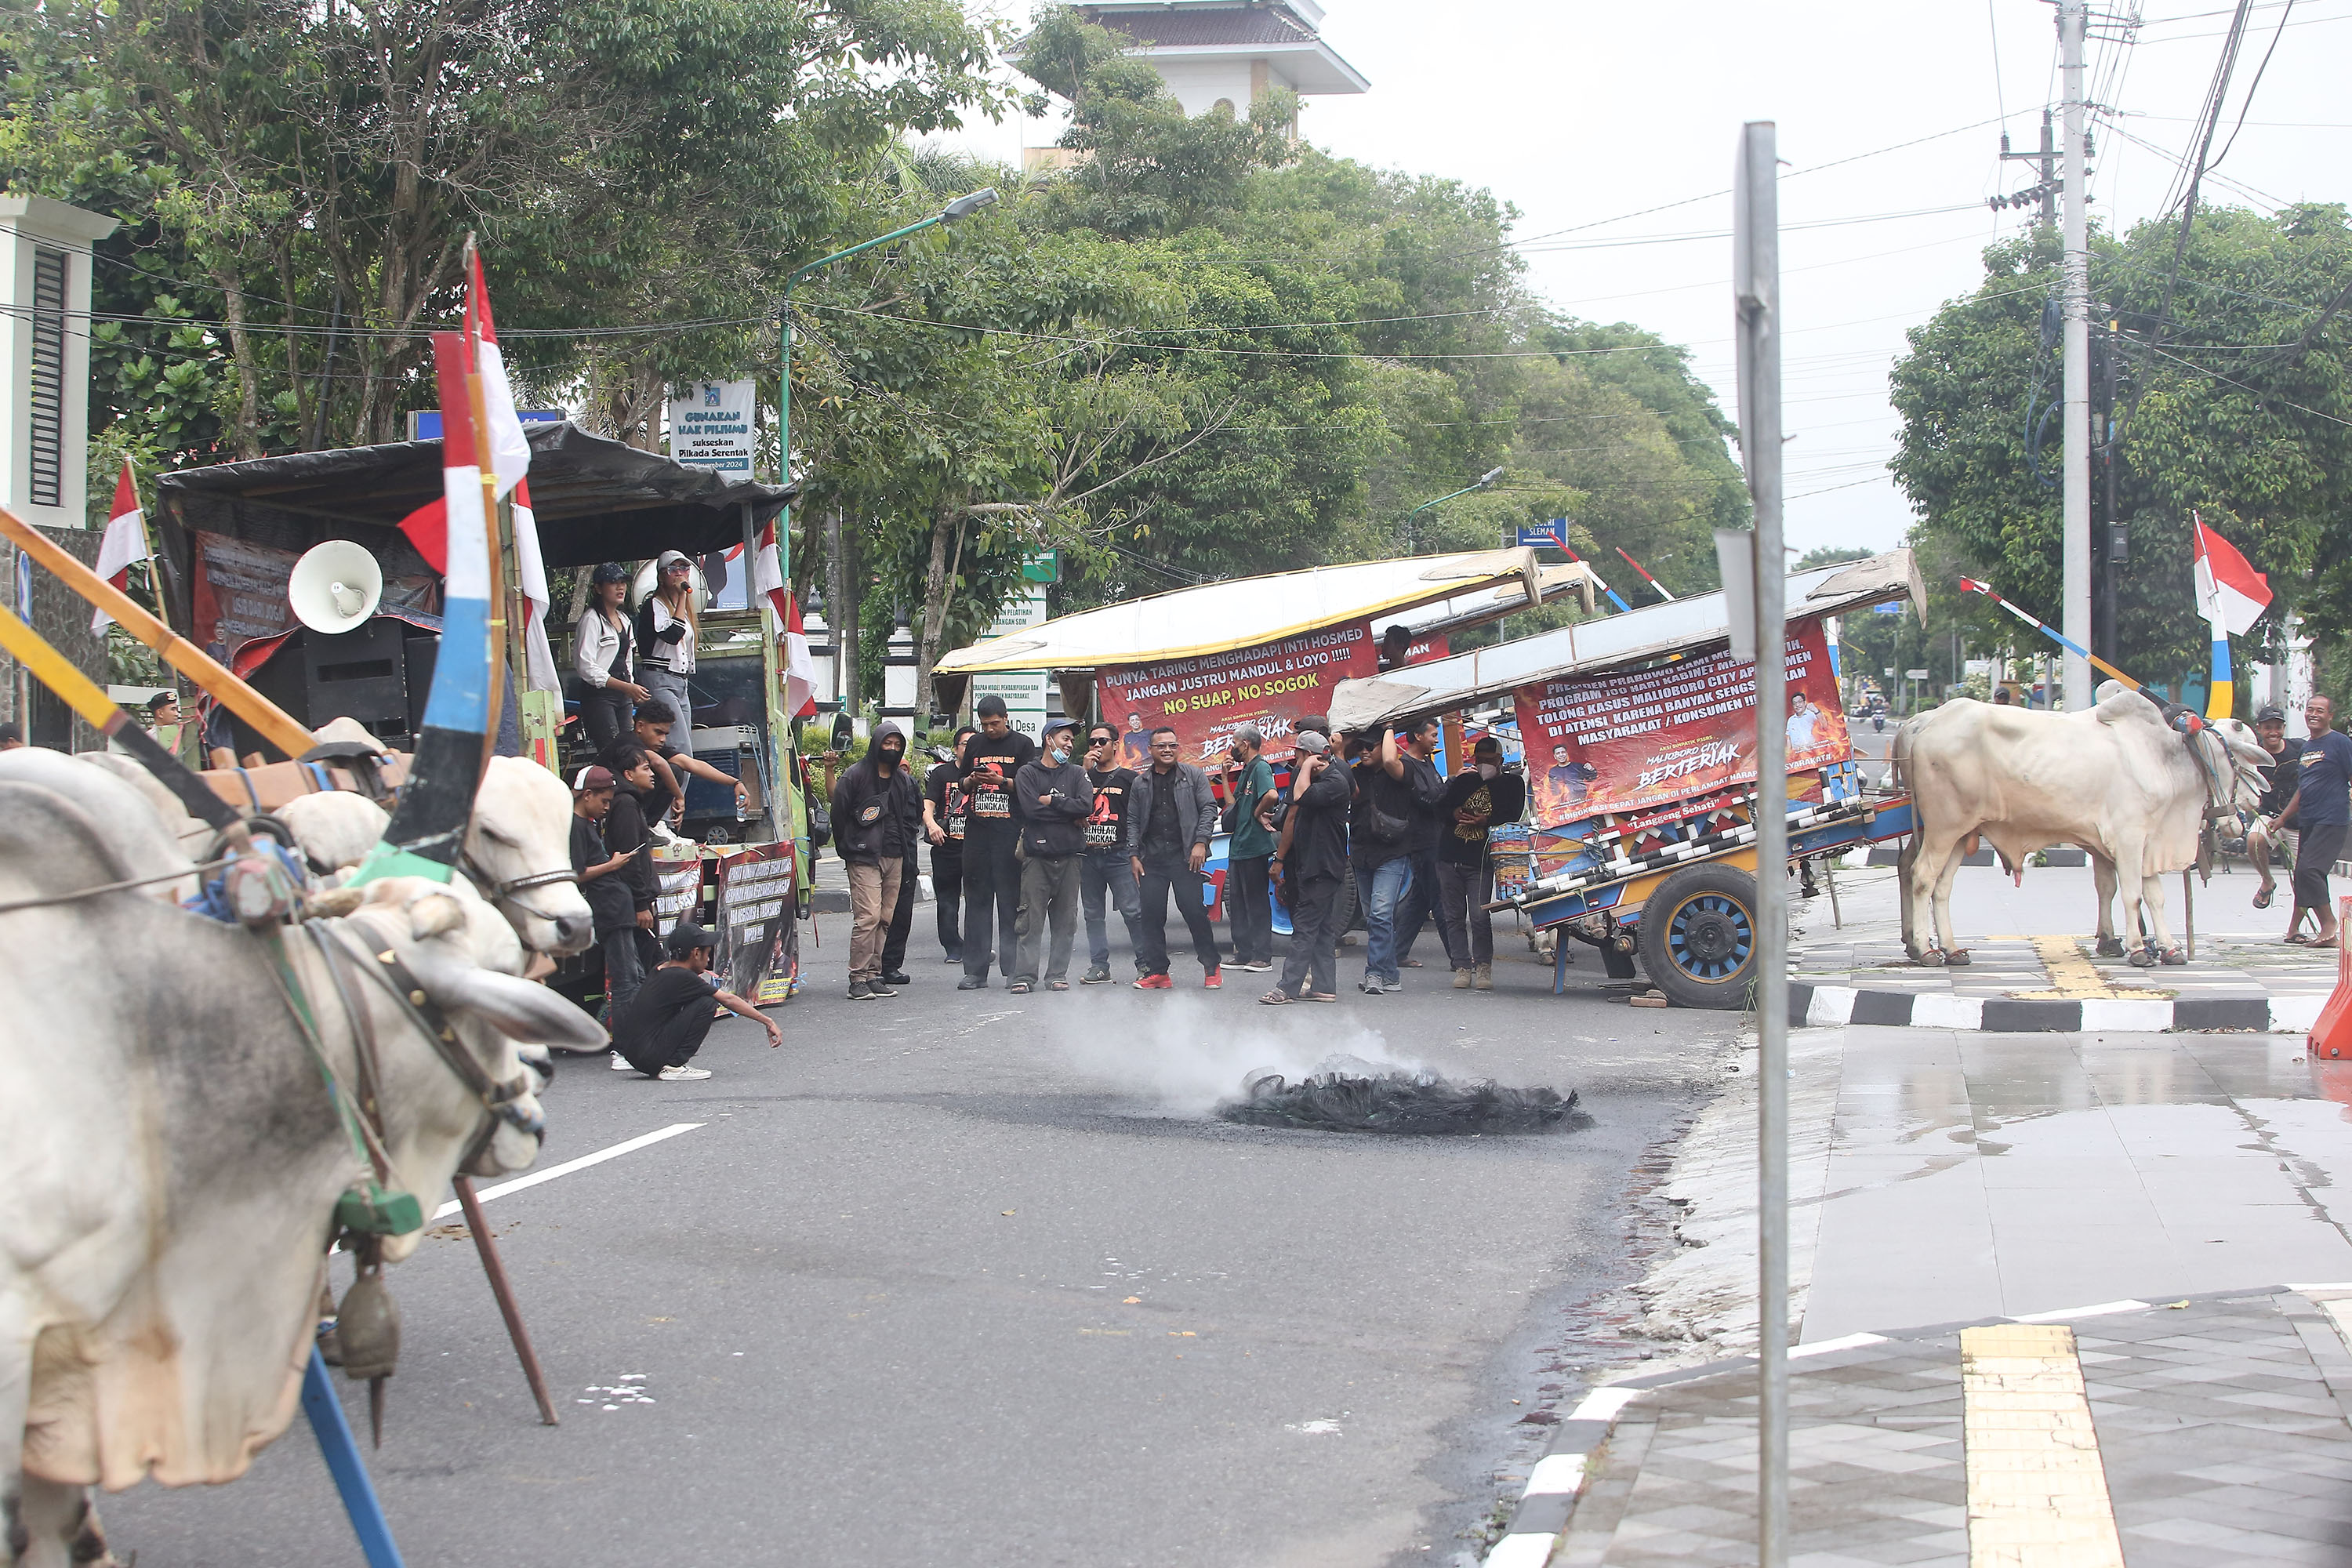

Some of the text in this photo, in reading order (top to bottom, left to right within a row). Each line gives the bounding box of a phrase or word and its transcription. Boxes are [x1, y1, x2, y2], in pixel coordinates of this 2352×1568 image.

[678, 424, 748, 435] HAK PILIHMU
[685, 411, 740, 422] GUNAKAN
[1105, 628, 1363, 688] PUNYA TARING MENGHADAPI INTI HOSMED
[1125, 681, 1178, 702] JANGAN
[1180, 671, 1227, 691] JUSTRU
[1229, 662, 1283, 682] MANDUL
[1285, 659, 1294, 671] &
[1296, 652, 1329, 669] LOYO
[1609, 666, 1674, 687] PRABOWO
[1675, 658, 1710, 672] KAMI
[1163, 672, 1320, 715] NO SUAP, NO SOGOK
[1536, 707, 1585, 725] TOLONG
[1587, 696, 1631, 715] KASUS
[1632, 680, 1706, 705] MALIOBORO
[1708, 670, 1737, 688] CITY
[1538, 690, 1602, 710] PROGRAM
[1603, 687, 1628, 697] 100
[1631, 680, 1661, 693] HARI
[1664, 664, 1715, 685] KABINET
[1016, 720, 1036, 732] Desa
[1232, 712, 1253, 720] SIMPATIK
[1258, 713, 1277, 725] CITY
[1548, 724, 1563, 738] DI
[1565, 715, 1607, 735] ATENSI
[1613, 705, 1664, 724] KARENA
[1665, 692, 1715, 712] BANYAK
[1577, 718, 1662, 746] MASYARAKAT
[1665, 716, 1671, 728] /
[1673, 698, 1743, 725] KONSUMEN
[1199, 717, 1294, 760] BERRIAK
[1646, 740, 1724, 765] MALIOBORO CITY
[1672, 739, 1696, 749] SIMPATIK
[1632, 742, 1742, 792] BERTERIAK
[975, 793, 1010, 804] MENOLAK
[1559, 804, 1608, 822] #BIROKRASI
[1609, 798, 1635, 810] CEPAT
[1636, 793, 1670, 805] JANGAN
[1671, 789, 1679, 798] DI
[1681, 777, 1729, 796] PERLAMBAT
